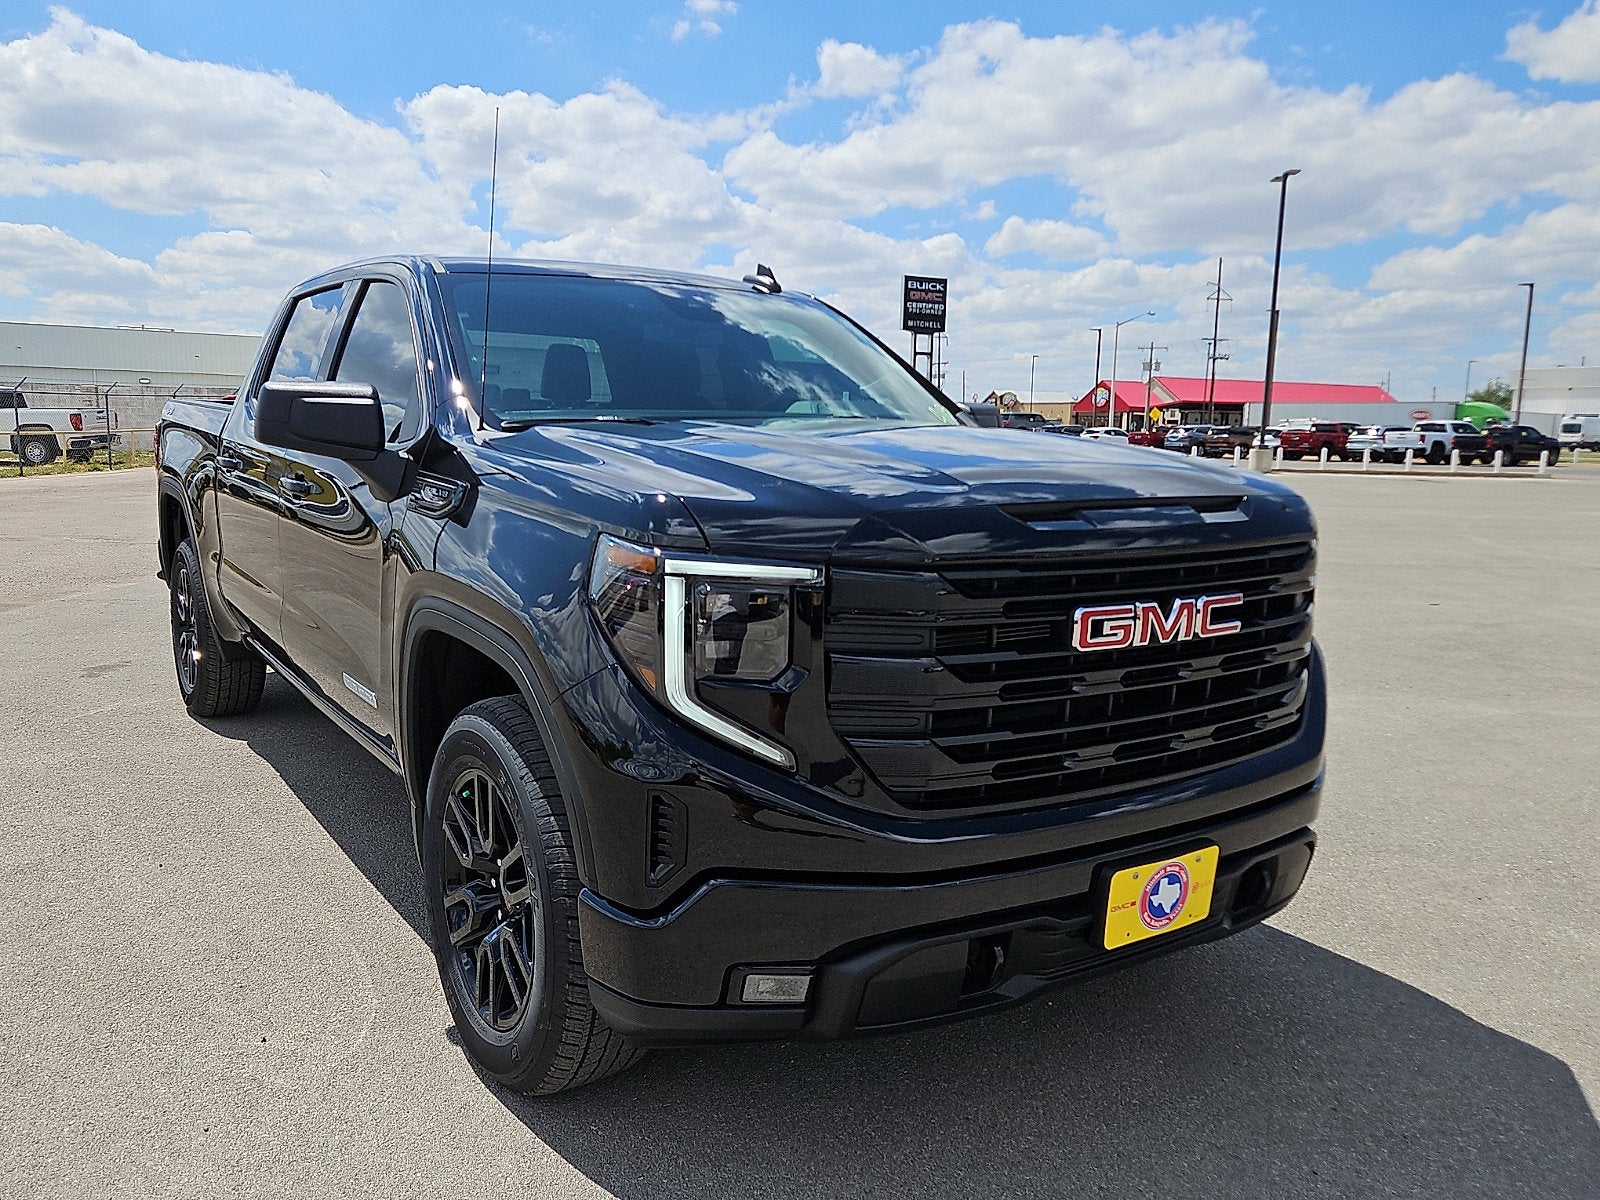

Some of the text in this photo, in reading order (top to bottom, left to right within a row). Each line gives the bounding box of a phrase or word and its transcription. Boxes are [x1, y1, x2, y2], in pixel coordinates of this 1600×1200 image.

[908, 281, 944, 290] BUICK
[910, 291, 943, 301] GMC
[907, 302, 944, 310] CERTIFIED
[908, 320, 941, 328] MITCHELL
[1072, 592, 1243, 652] GMC
[1110, 902, 1130, 913] GMC
